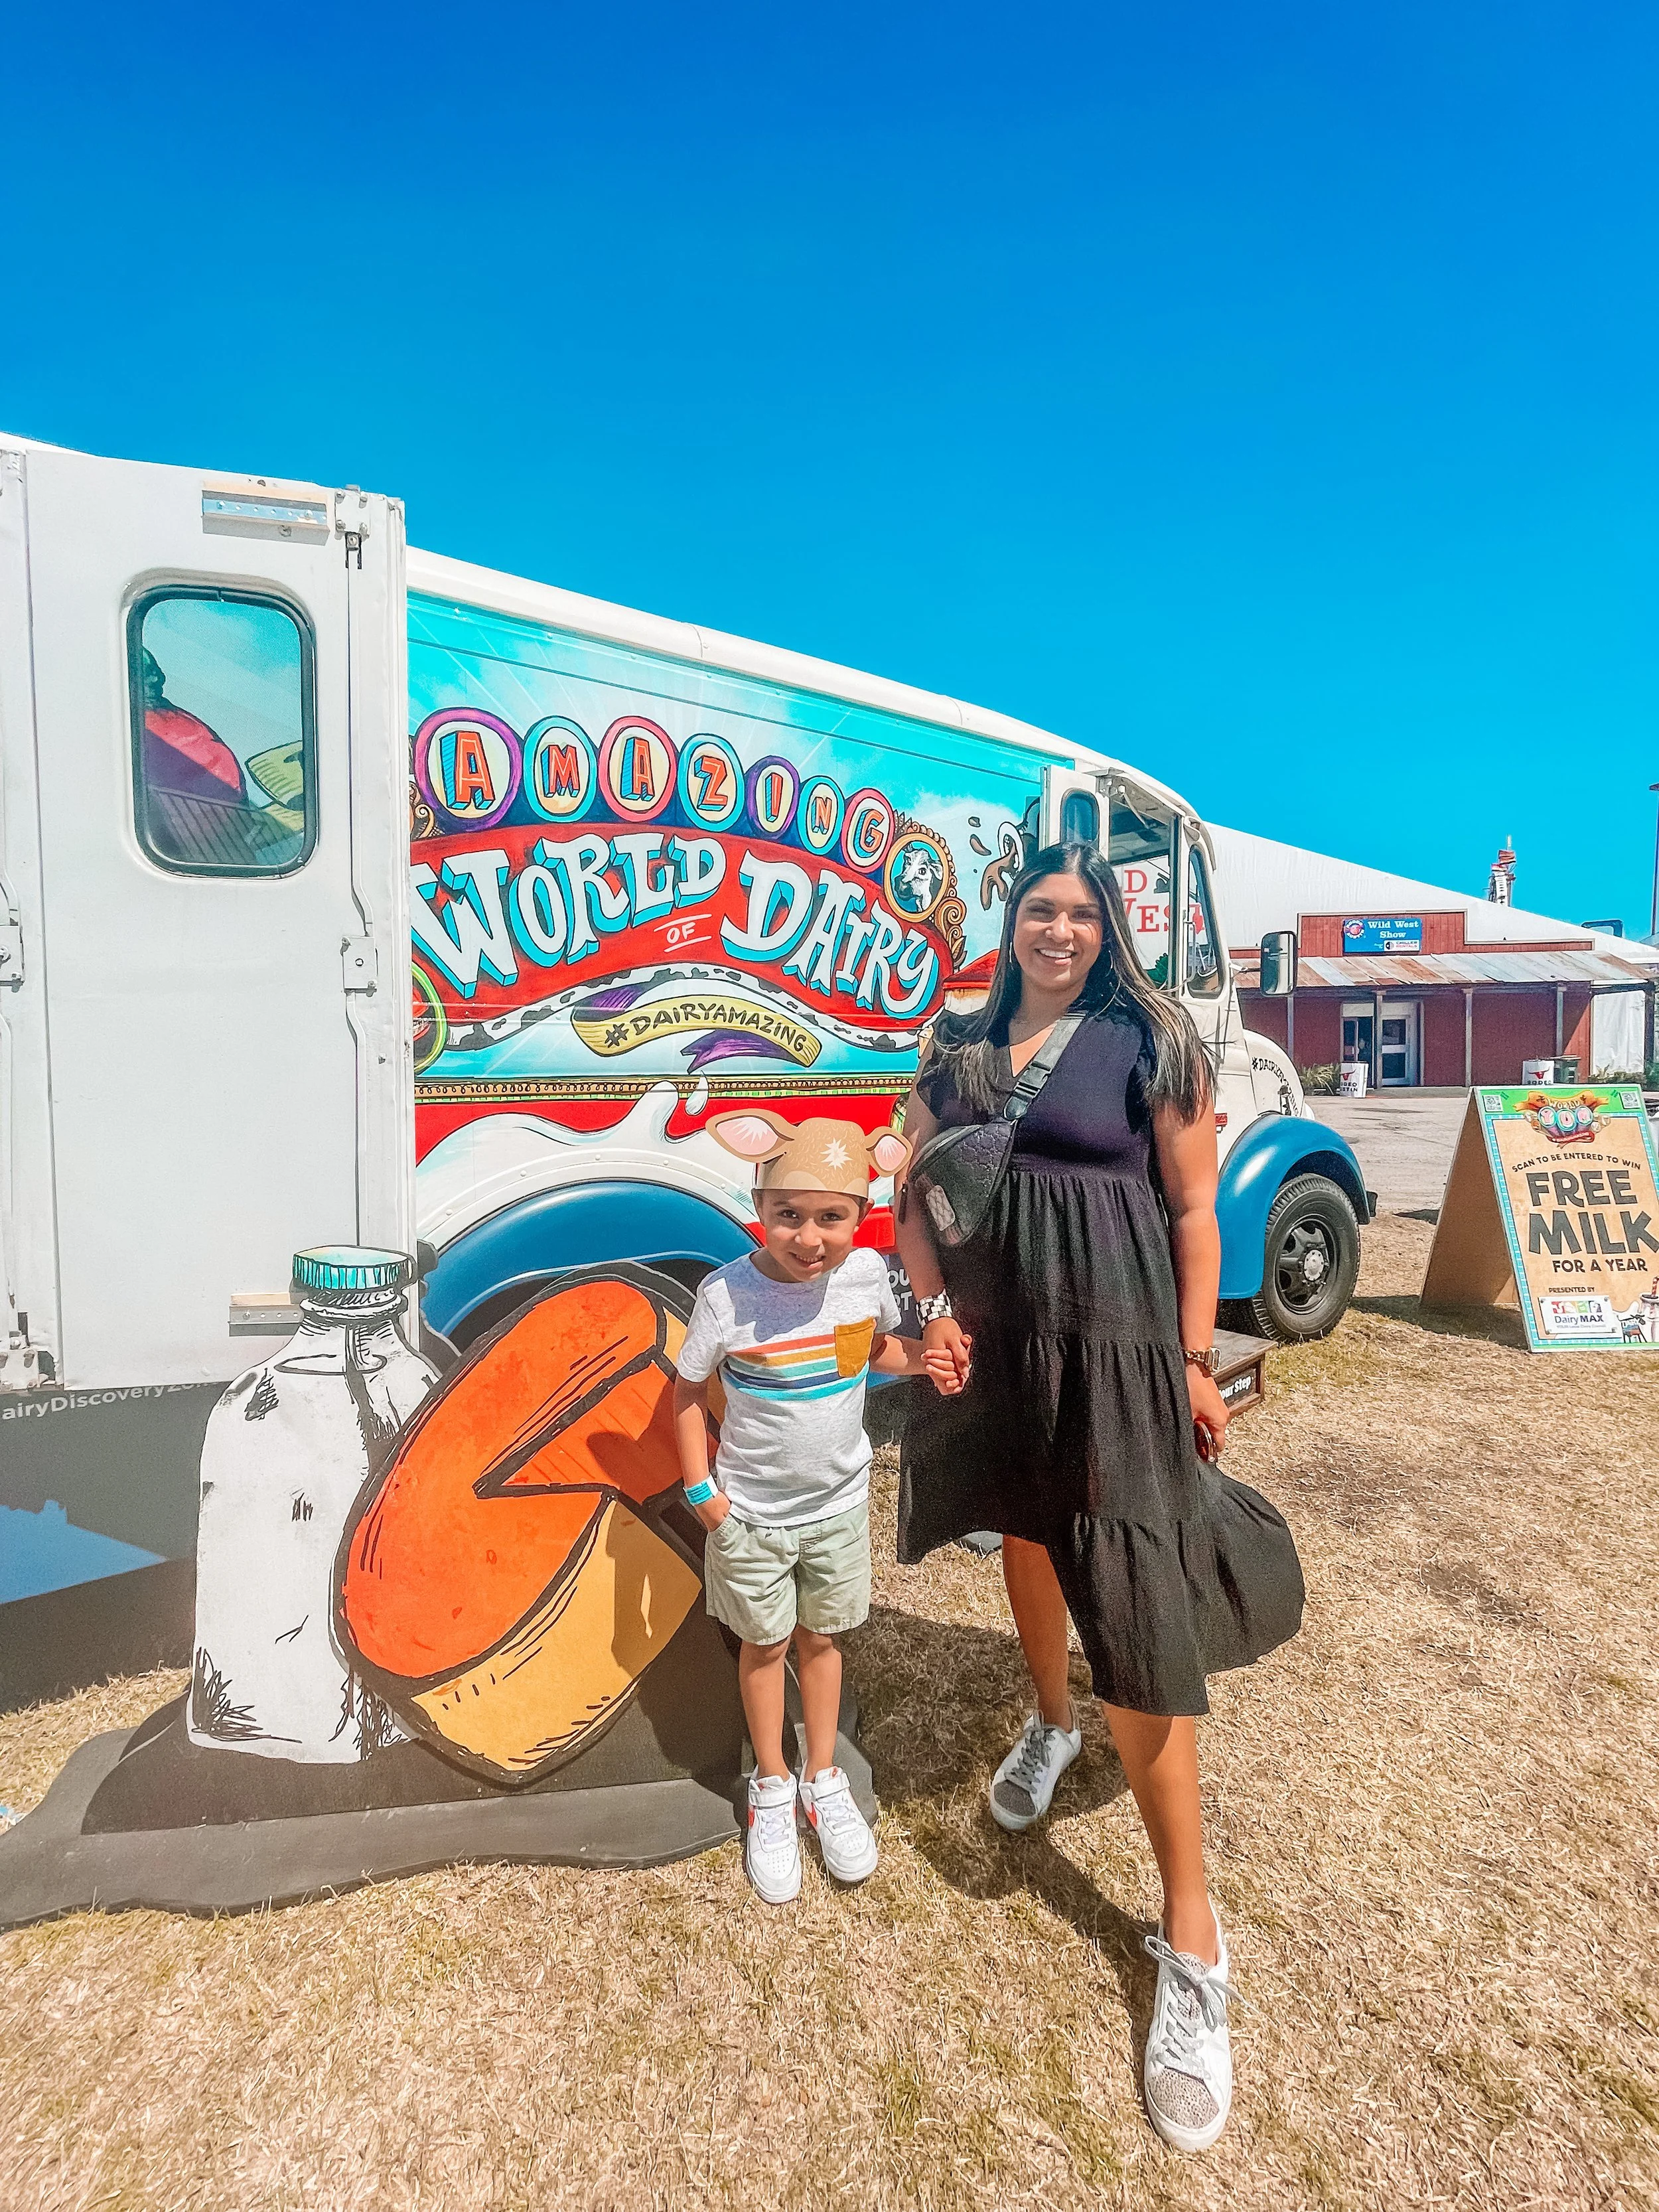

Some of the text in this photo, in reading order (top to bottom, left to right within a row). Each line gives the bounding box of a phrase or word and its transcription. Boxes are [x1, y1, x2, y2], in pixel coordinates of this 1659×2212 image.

[439, 729, 883, 859] AMAZING
[412, 832, 727, 999] WORLD
[664, 921, 696, 946] OF
[605, 1003, 807, 1053] #DAIRYAMAZING
[1512, 1157, 1536, 1172] SCAN
[1622, 1159, 1641, 1170] WIN
[1526, 1170, 1638, 1208] FREE
[1528, 1210, 1659, 1255] MILK
[1552, 1258, 1648, 1273] FOR A YEAR
[1554, 1315, 1579, 1325] Dairy
[1218, 1384, 1234, 1400] our
